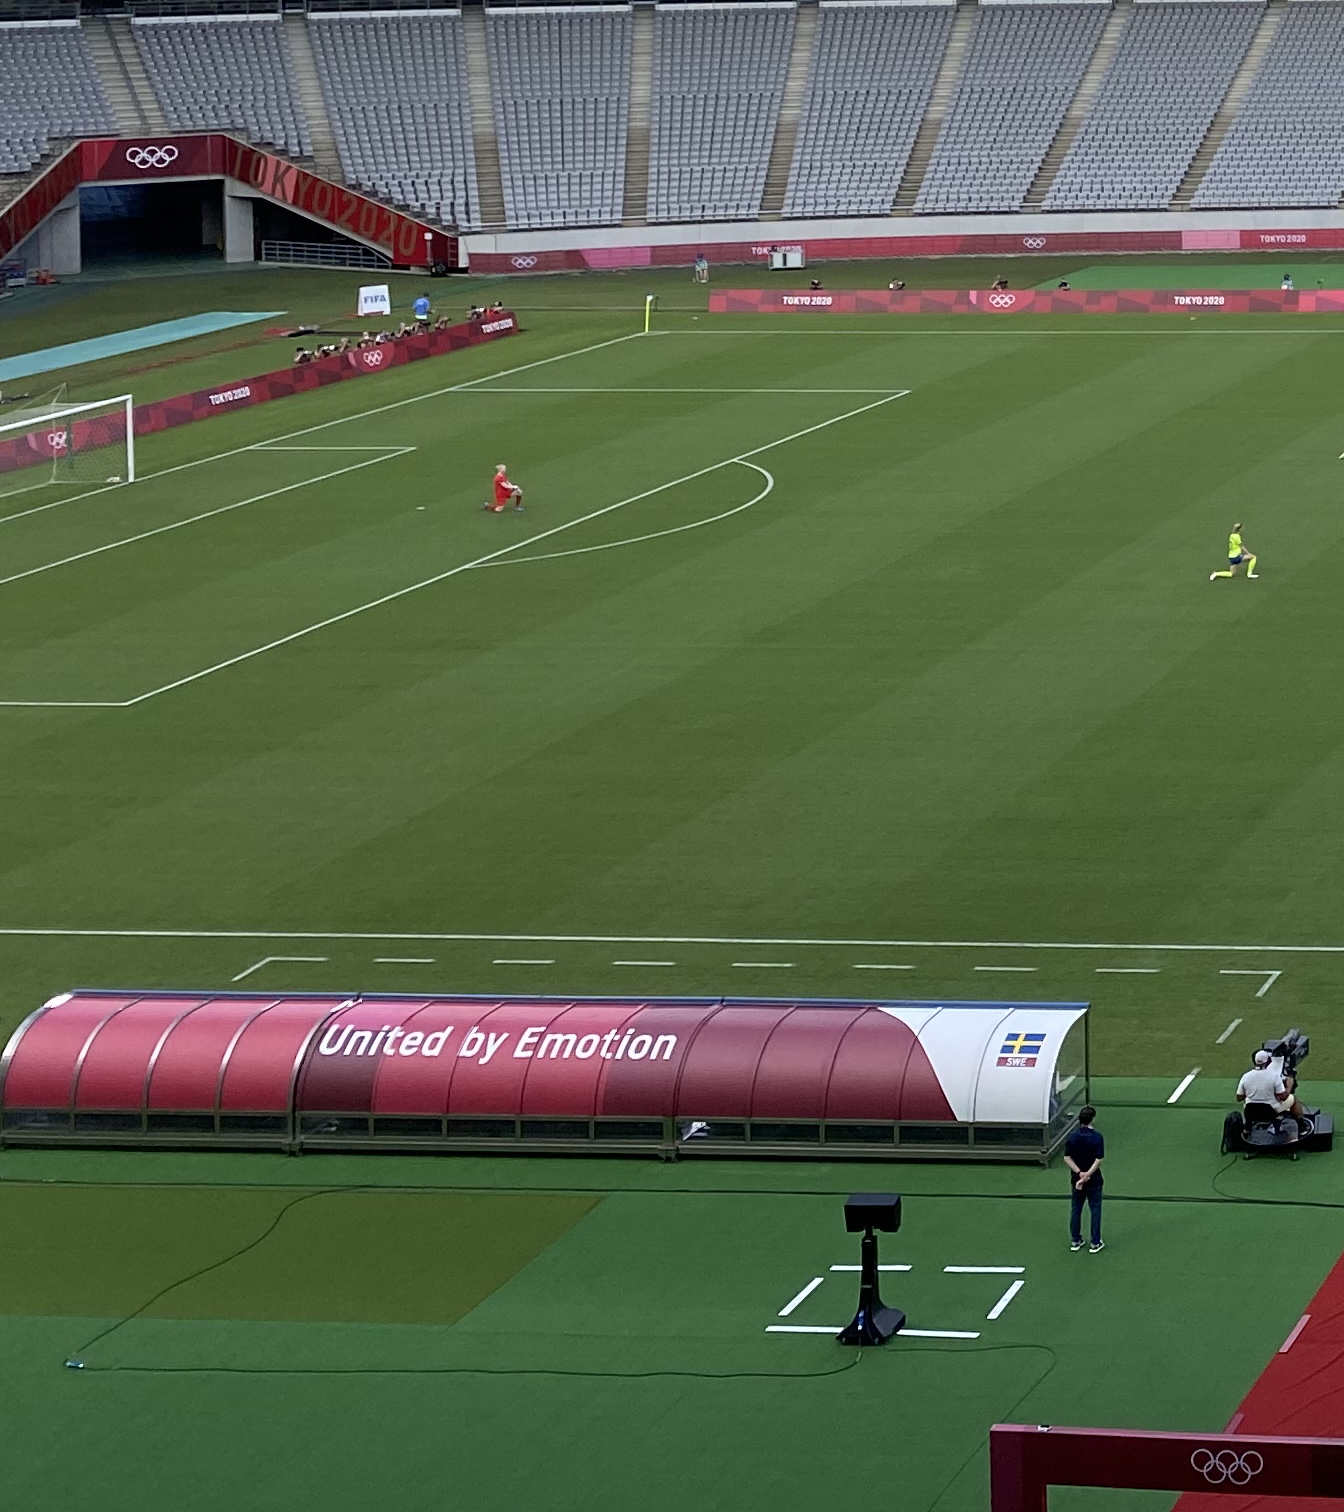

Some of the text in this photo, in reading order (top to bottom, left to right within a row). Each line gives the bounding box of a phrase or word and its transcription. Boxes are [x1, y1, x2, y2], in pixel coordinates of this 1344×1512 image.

[228, 140, 418, 257] TOKYO 2020
[1260, 234, 1306, 243] TOKYO 2020
[364, 294, 387, 305] FIFA
[782, 296, 832, 306] TOKYO 2020
[1174, 296, 1225, 306] TOKYO 2020
[319, 1024, 678, 1065] United by Emotion
[1006, 1058, 1027, 1067] SWE
